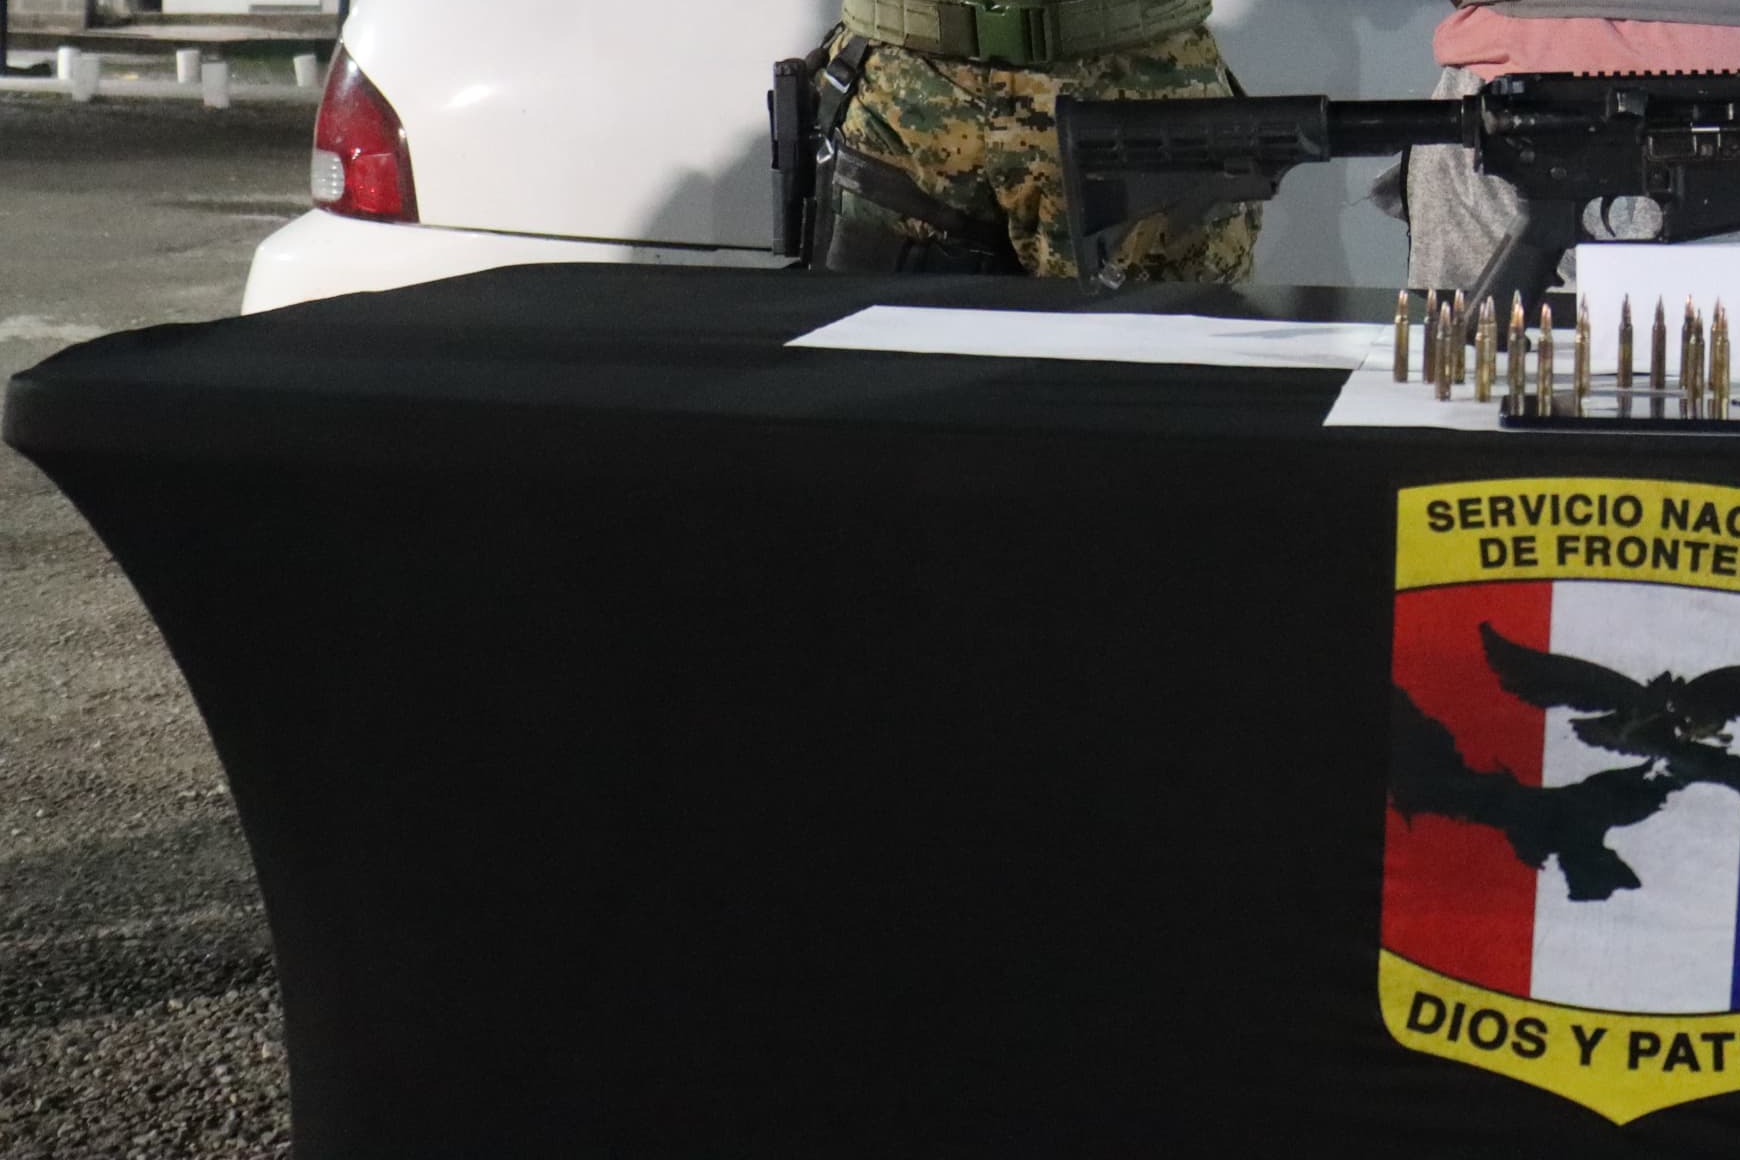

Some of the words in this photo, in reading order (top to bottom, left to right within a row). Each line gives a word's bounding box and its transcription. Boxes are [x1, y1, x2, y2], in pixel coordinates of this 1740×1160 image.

[1426, 493, 1643, 533] SERVICIO
[1479, 535, 1539, 569] DE
[1406, 991, 1549, 1060] DIOS
[1571, 1024, 1608, 1067] Y
